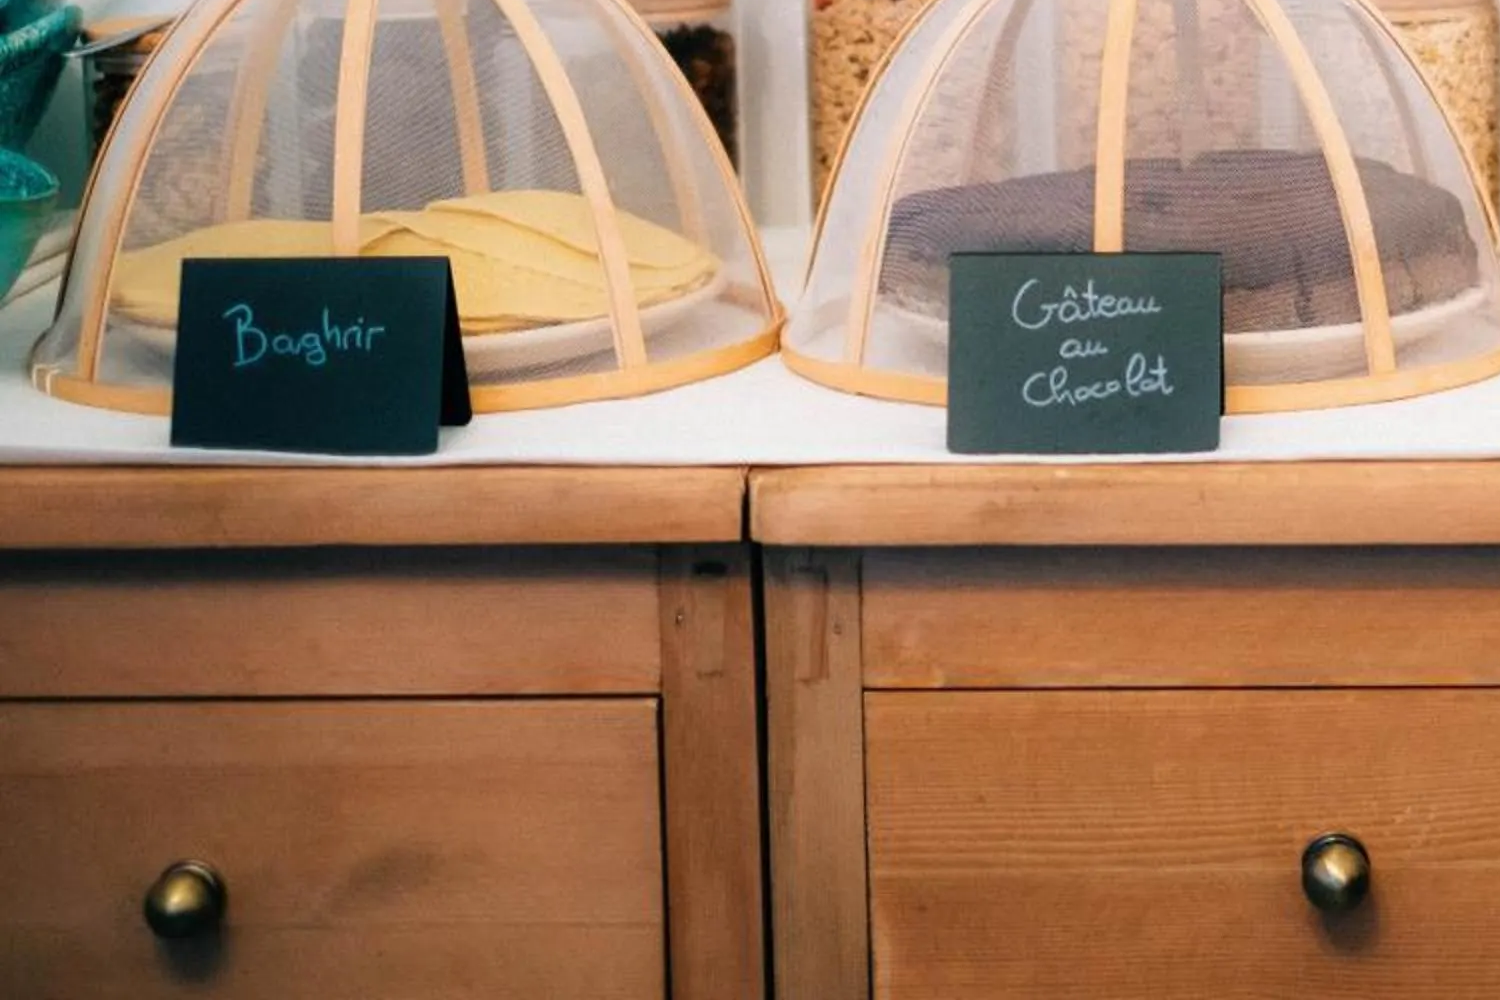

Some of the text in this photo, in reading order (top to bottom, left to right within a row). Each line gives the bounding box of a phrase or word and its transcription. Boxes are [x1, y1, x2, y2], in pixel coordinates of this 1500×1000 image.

[1012, 279, 1162, 329] Gâteau
[222, 303, 385, 366] Baghrir
[1059, 339, 1108, 358] au
